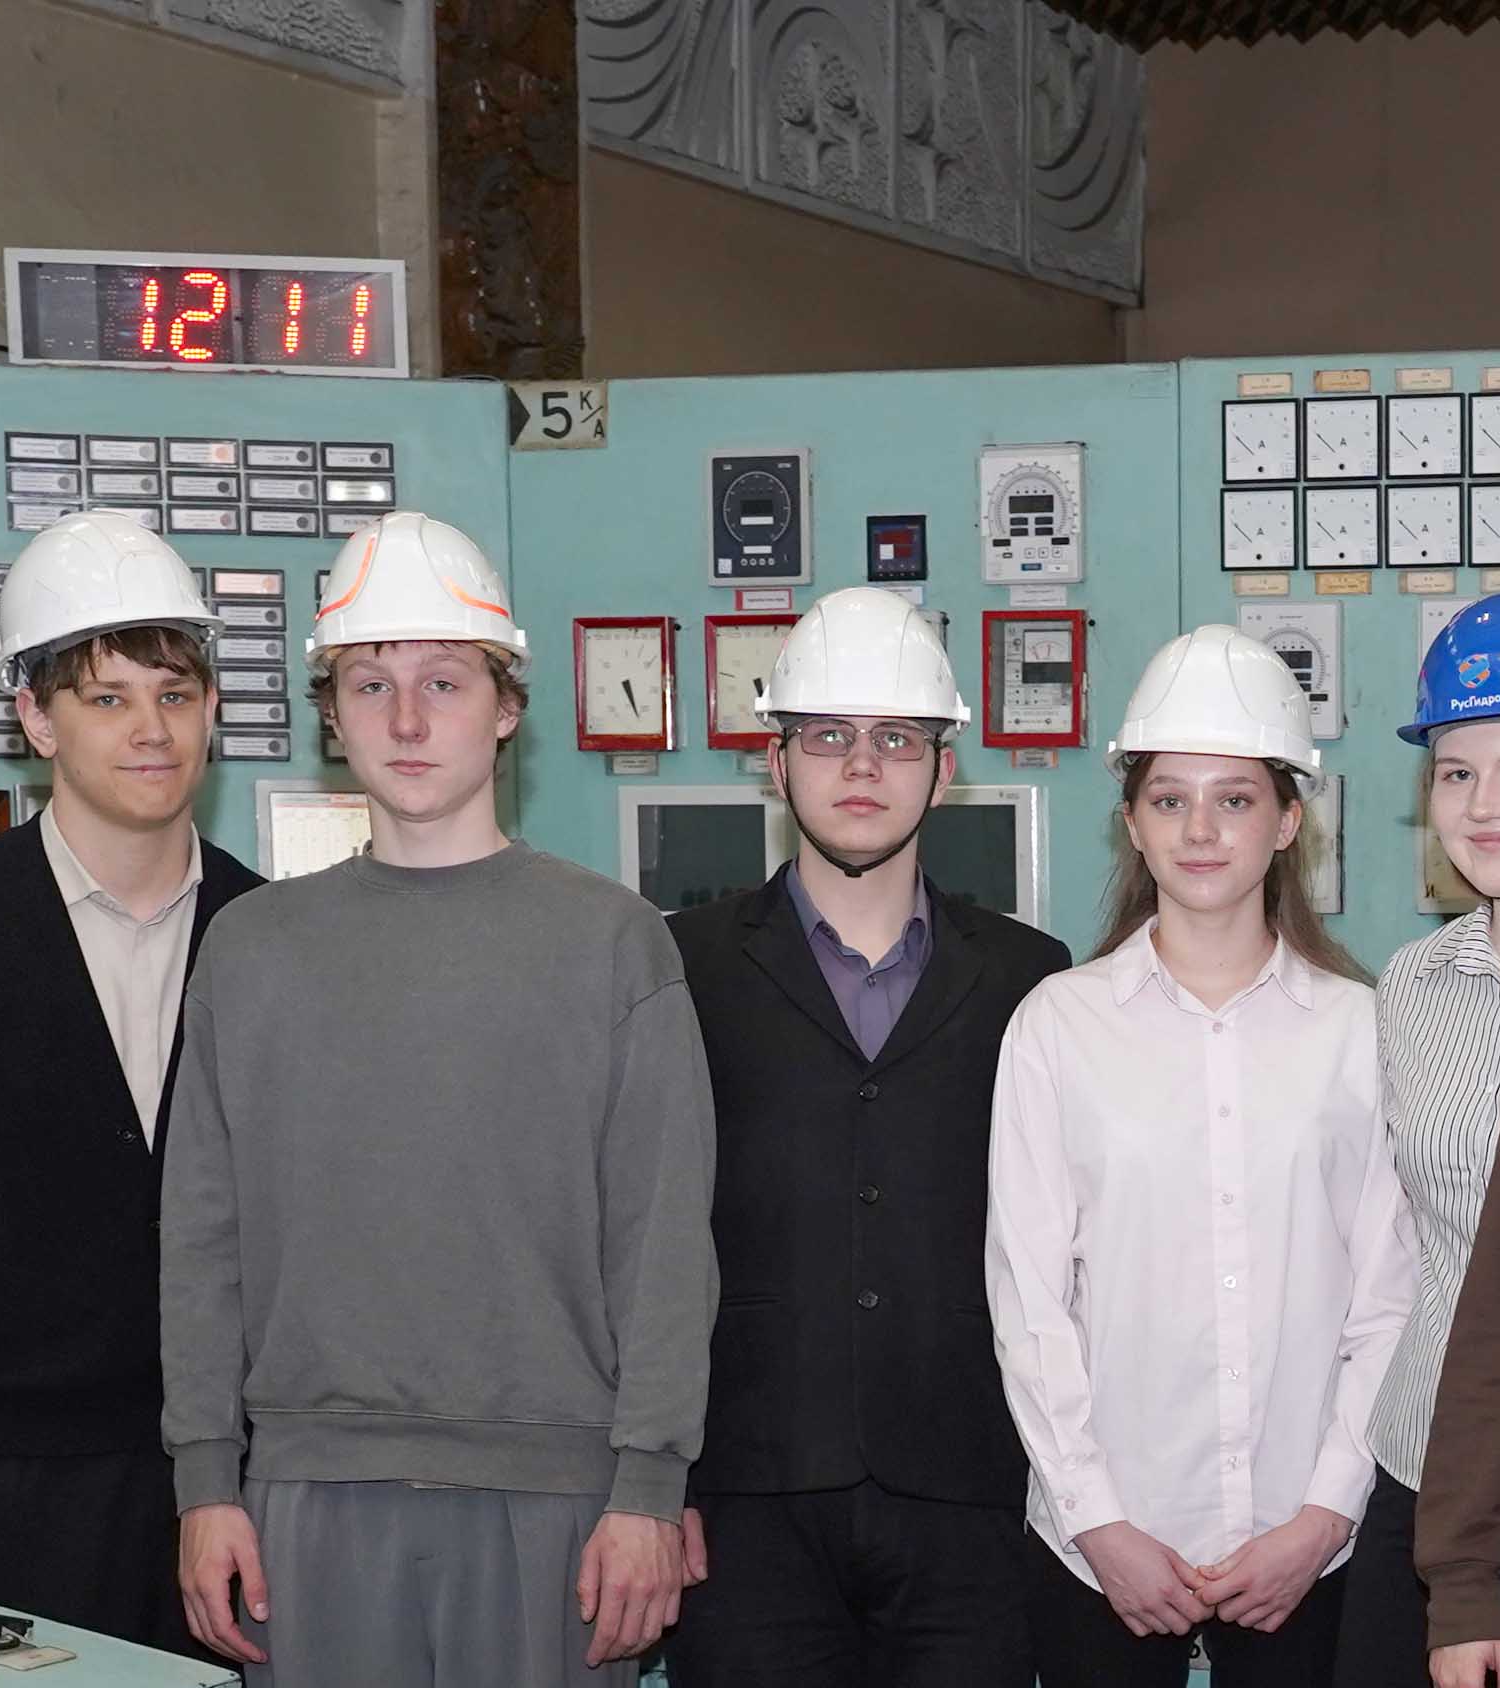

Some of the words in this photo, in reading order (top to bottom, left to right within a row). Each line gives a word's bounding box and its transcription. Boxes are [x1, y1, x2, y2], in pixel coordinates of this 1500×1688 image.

[140, 271, 228, 361] 12
[283, 282, 371, 358] 11
[540, 391, 573, 439] 5
